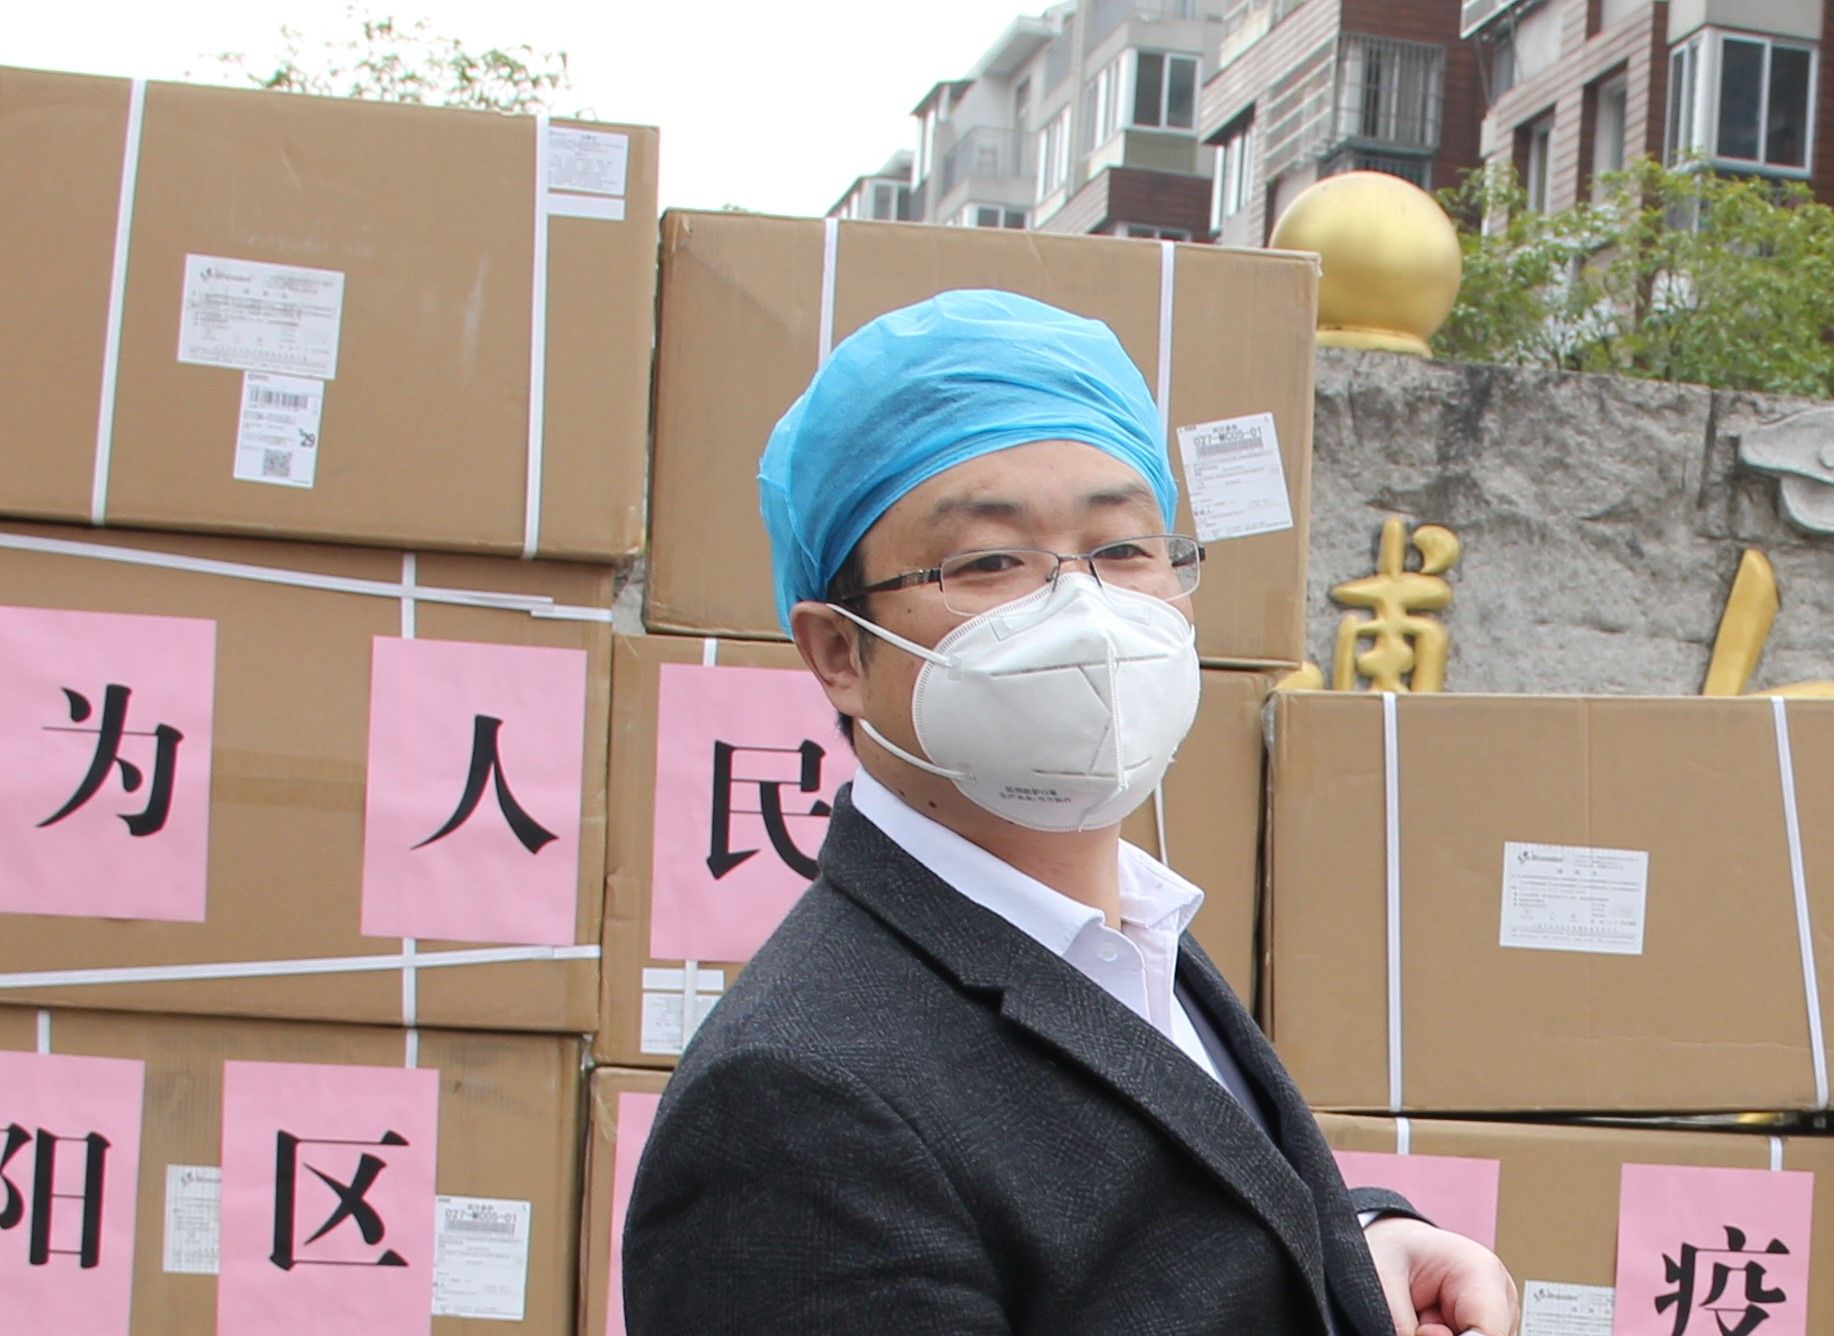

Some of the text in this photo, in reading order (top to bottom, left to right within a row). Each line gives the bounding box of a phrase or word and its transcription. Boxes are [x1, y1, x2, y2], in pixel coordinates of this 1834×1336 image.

[36, 683, 833, 881] 为 人 民
[0, 1122, 112, 1269] 阳
[269, 1128, 410, 1272] 区
